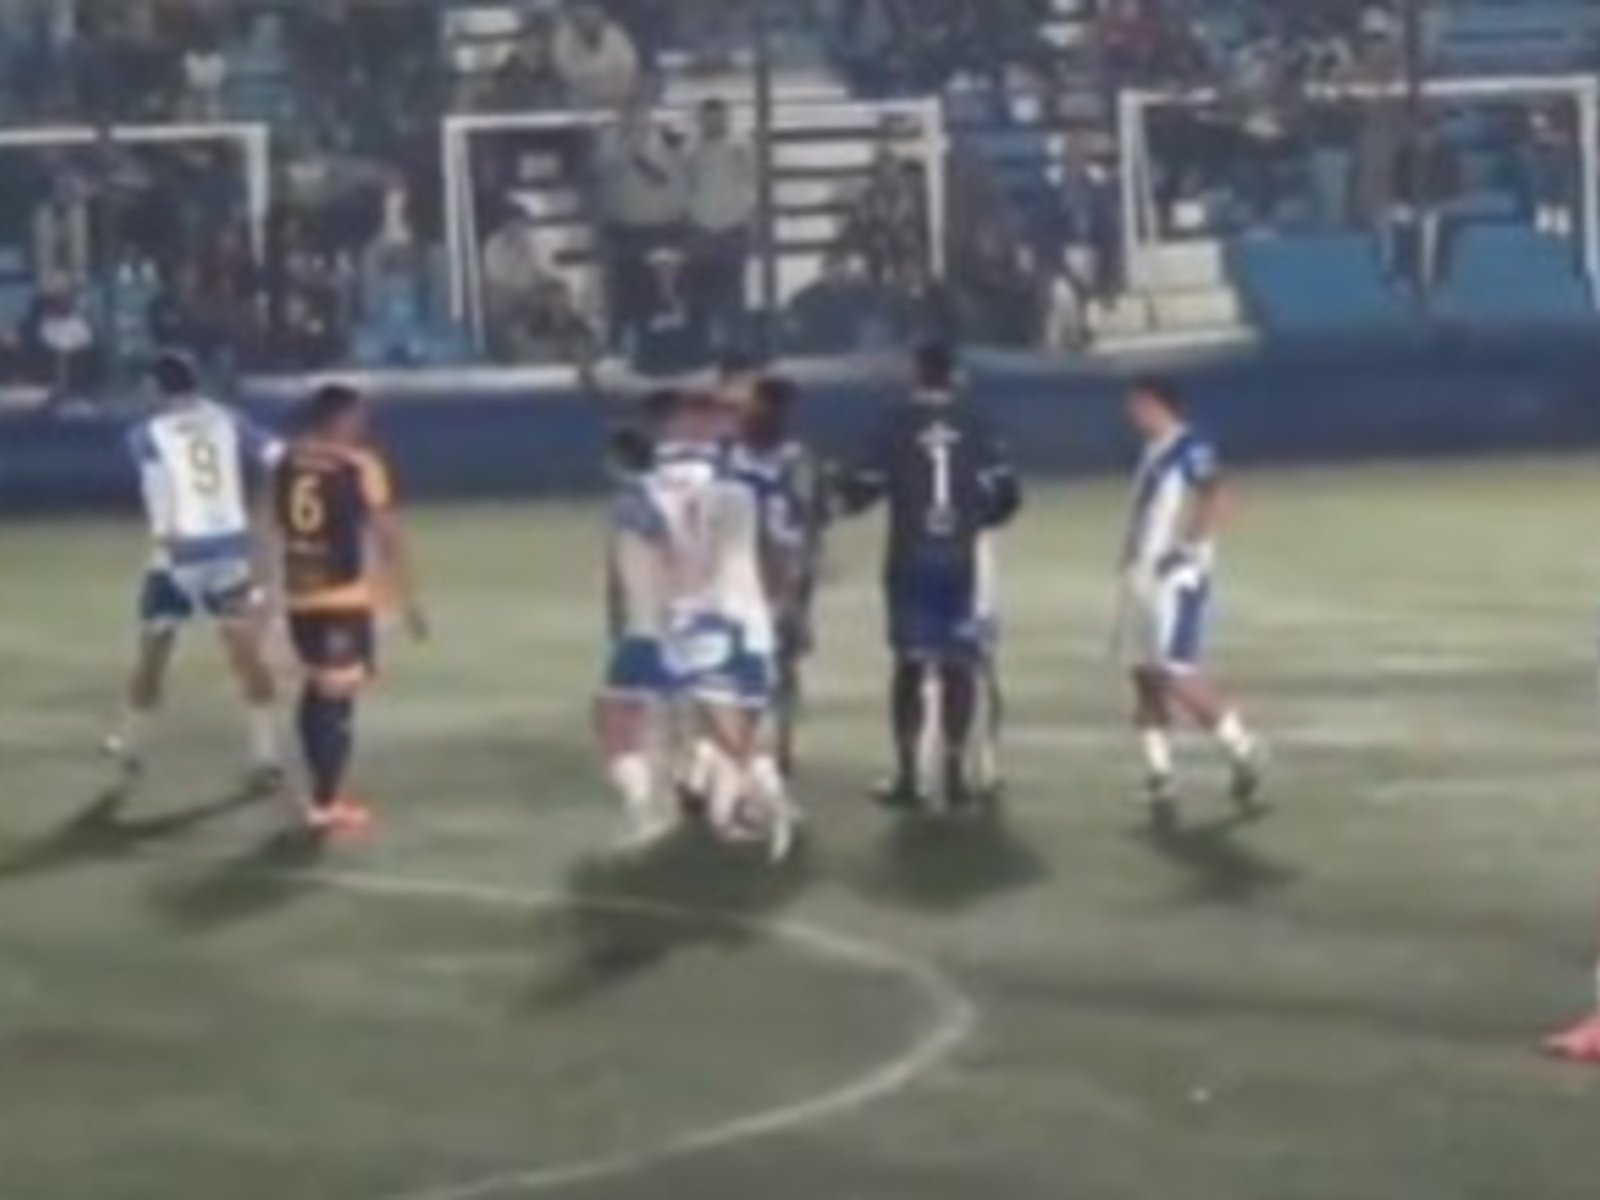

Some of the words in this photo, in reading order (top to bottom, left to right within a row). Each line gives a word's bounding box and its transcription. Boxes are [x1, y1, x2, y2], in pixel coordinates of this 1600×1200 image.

[190, 438, 219, 495] 9
[928, 443, 950, 507] 1
[289, 473, 323, 532] 6
